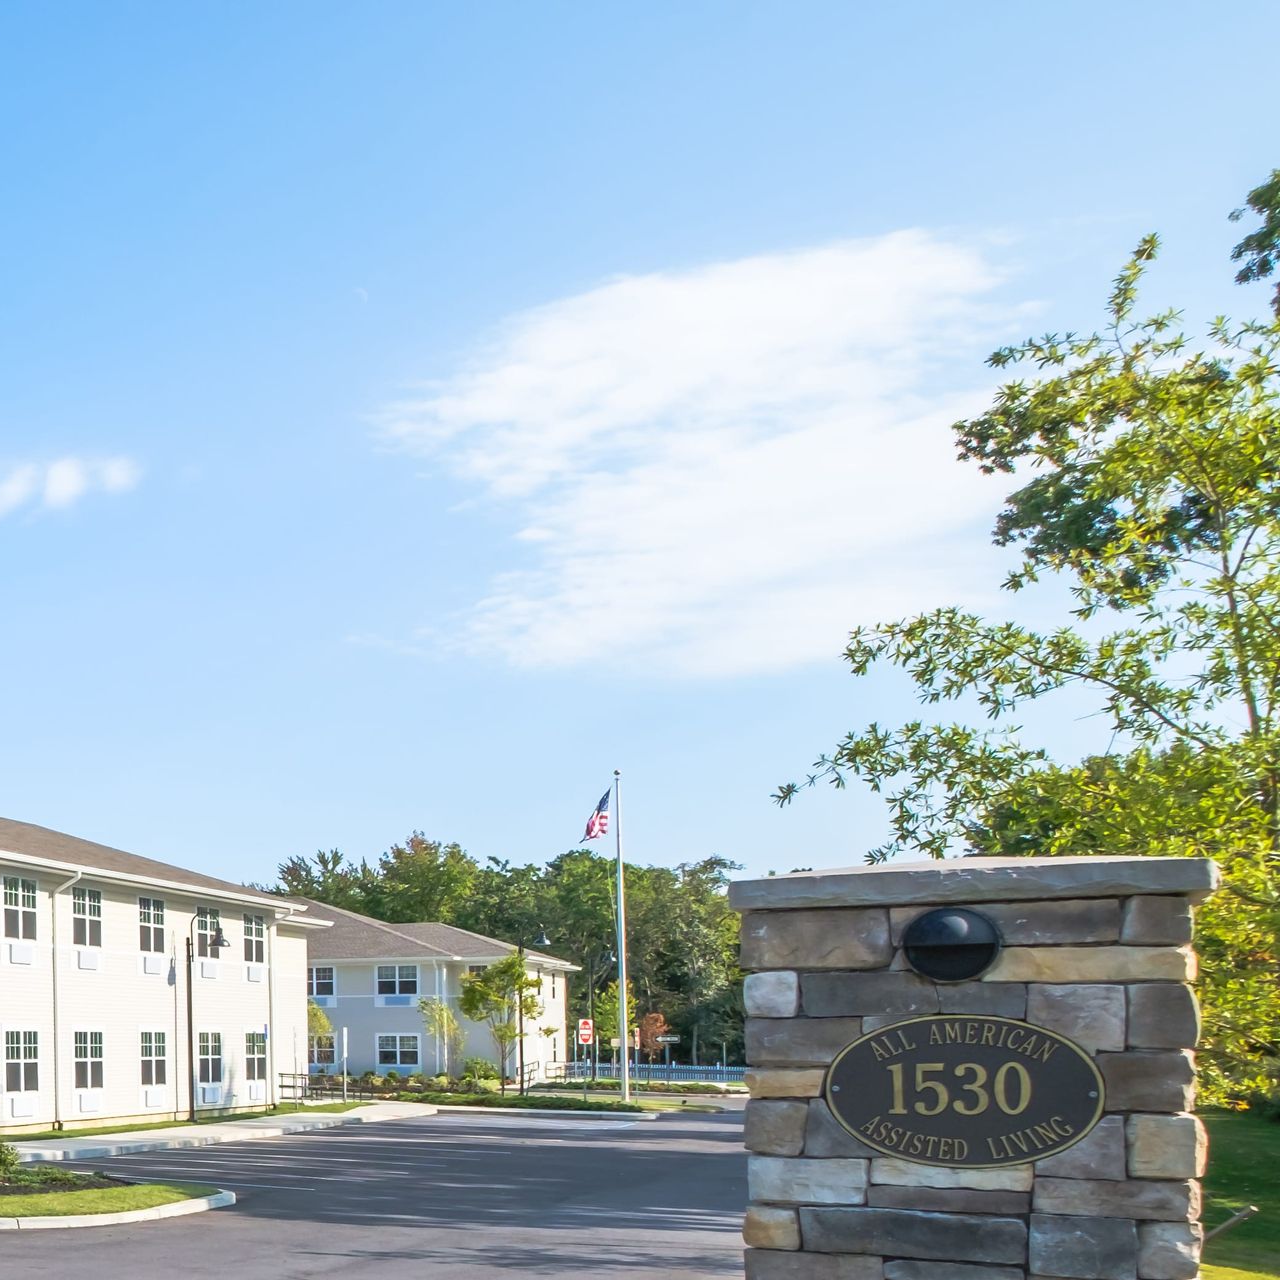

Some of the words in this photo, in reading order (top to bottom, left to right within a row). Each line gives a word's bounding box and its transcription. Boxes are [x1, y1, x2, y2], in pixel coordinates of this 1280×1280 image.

[870, 1030, 917, 1061] ALL
[929, 1022, 1060, 1063] AMERICAN
[886, 1061, 1032, 1115] 1530
[859, 1115, 968, 1161] ASSISTED
[987, 1116, 1074, 1159] LIVING
